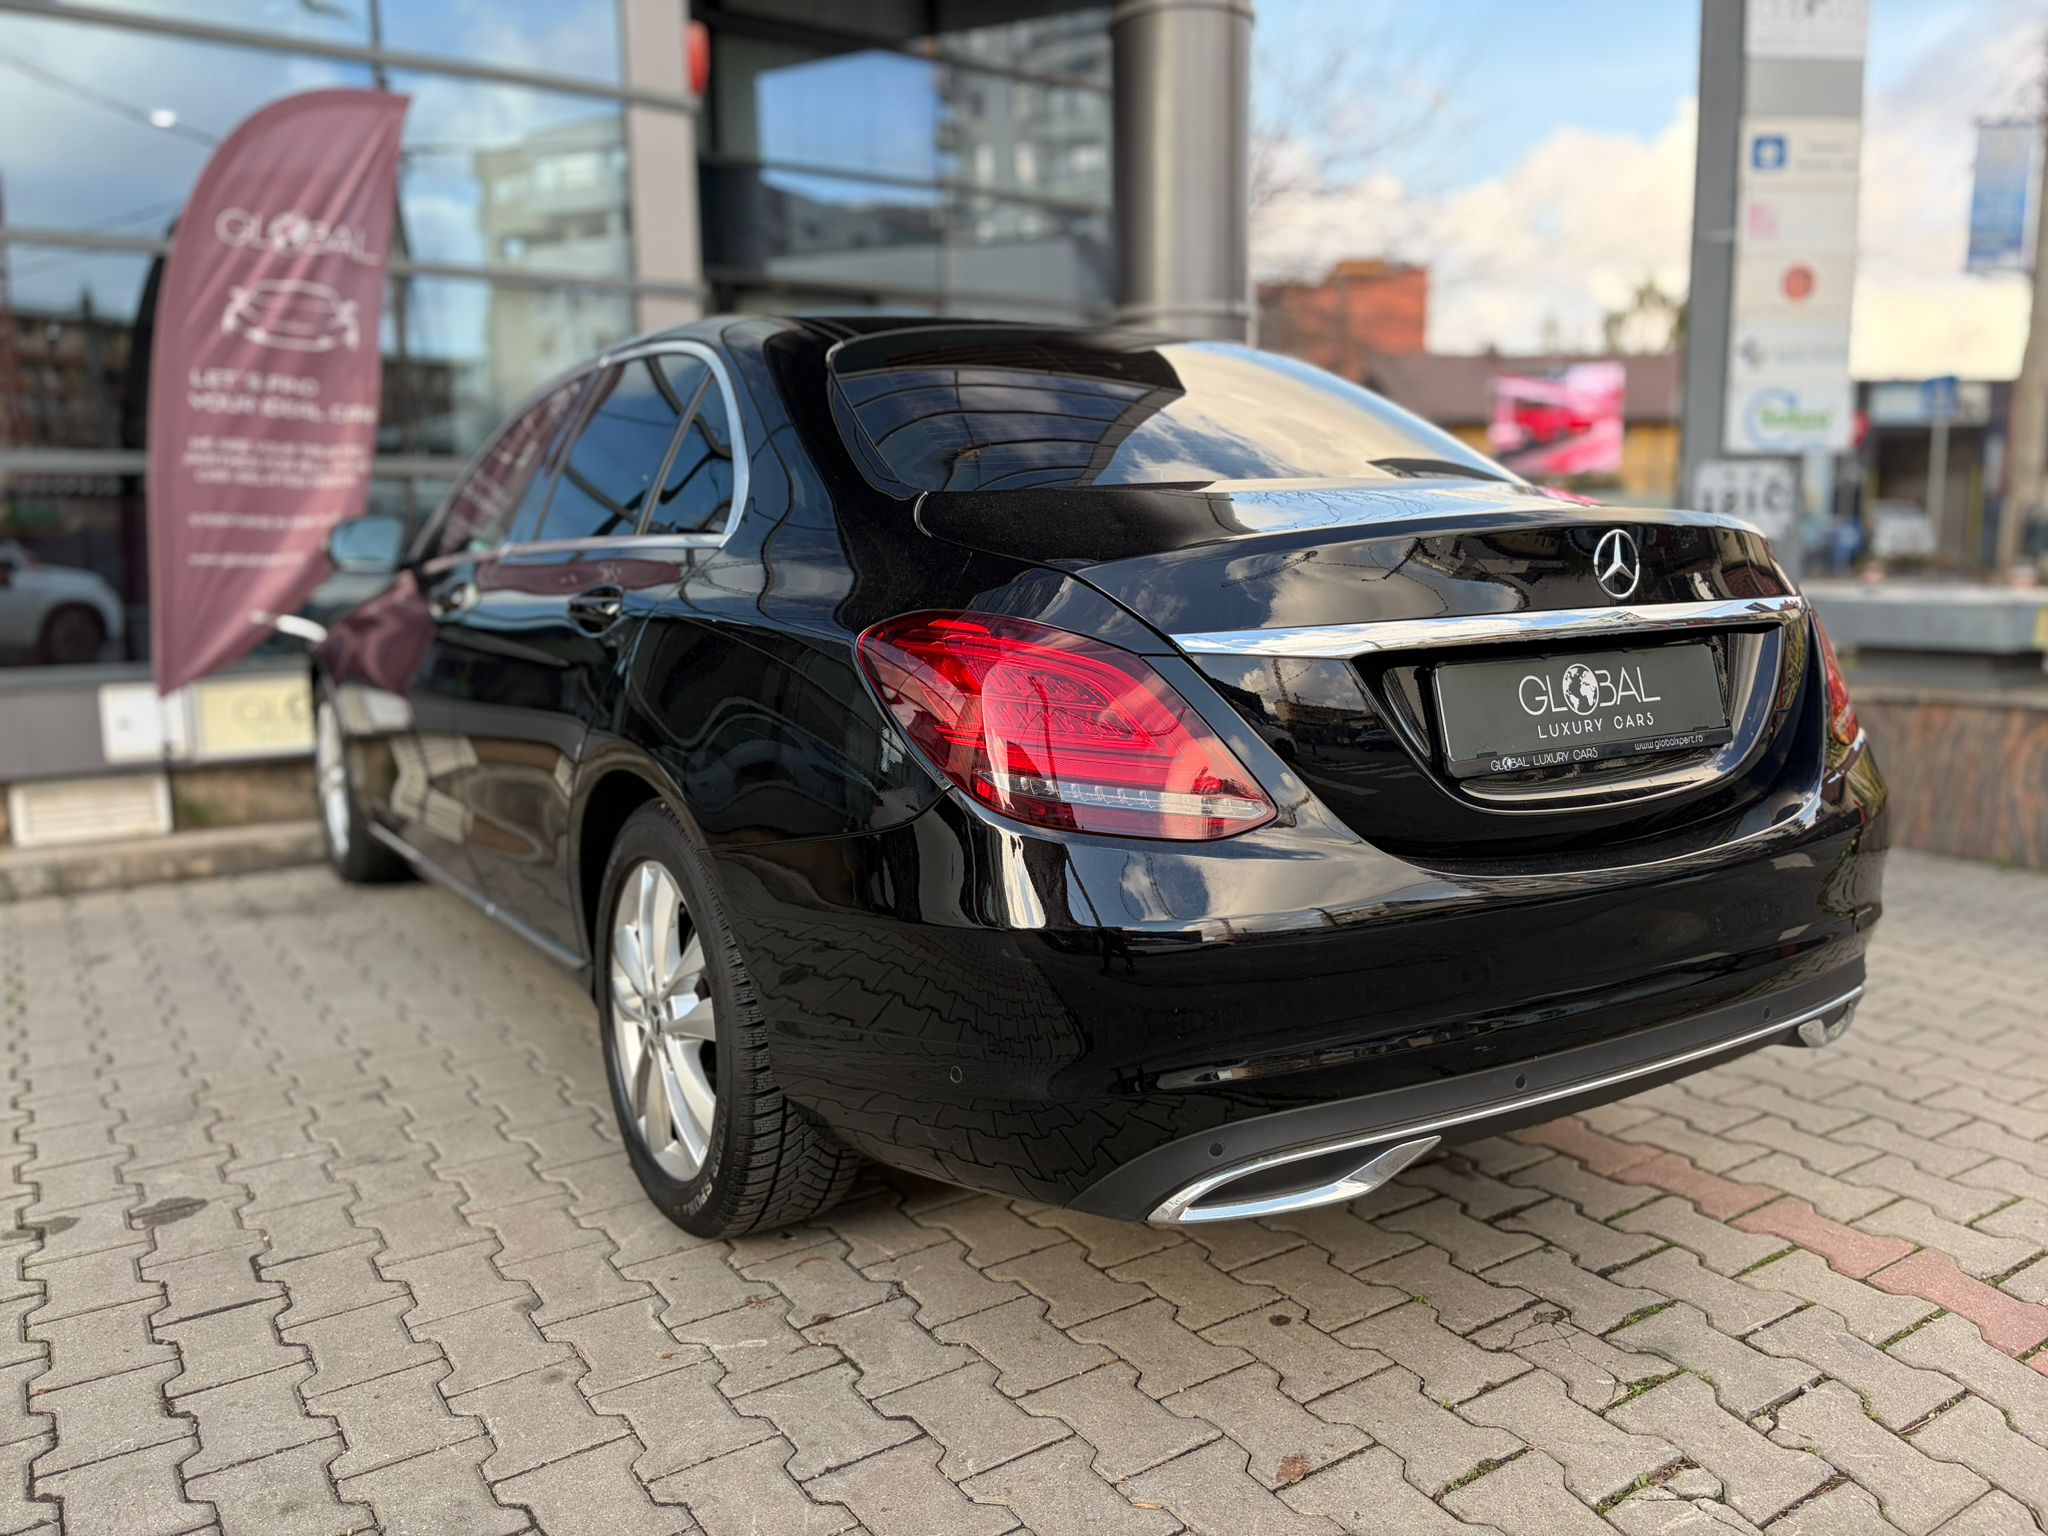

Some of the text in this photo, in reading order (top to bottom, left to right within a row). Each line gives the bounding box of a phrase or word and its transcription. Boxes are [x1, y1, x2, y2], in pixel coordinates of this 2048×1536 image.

[215, 207, 379, 267] GLOBAL
[1518, 663, 1661, 716] GLOBAL
[1537, 711, 1655, 739] LUXURY CARS
[1634, 734, 1704, 751] www.globalxpert.ro
[1490, 747, 1598, 772] GLOBAL LUXURY CARS
